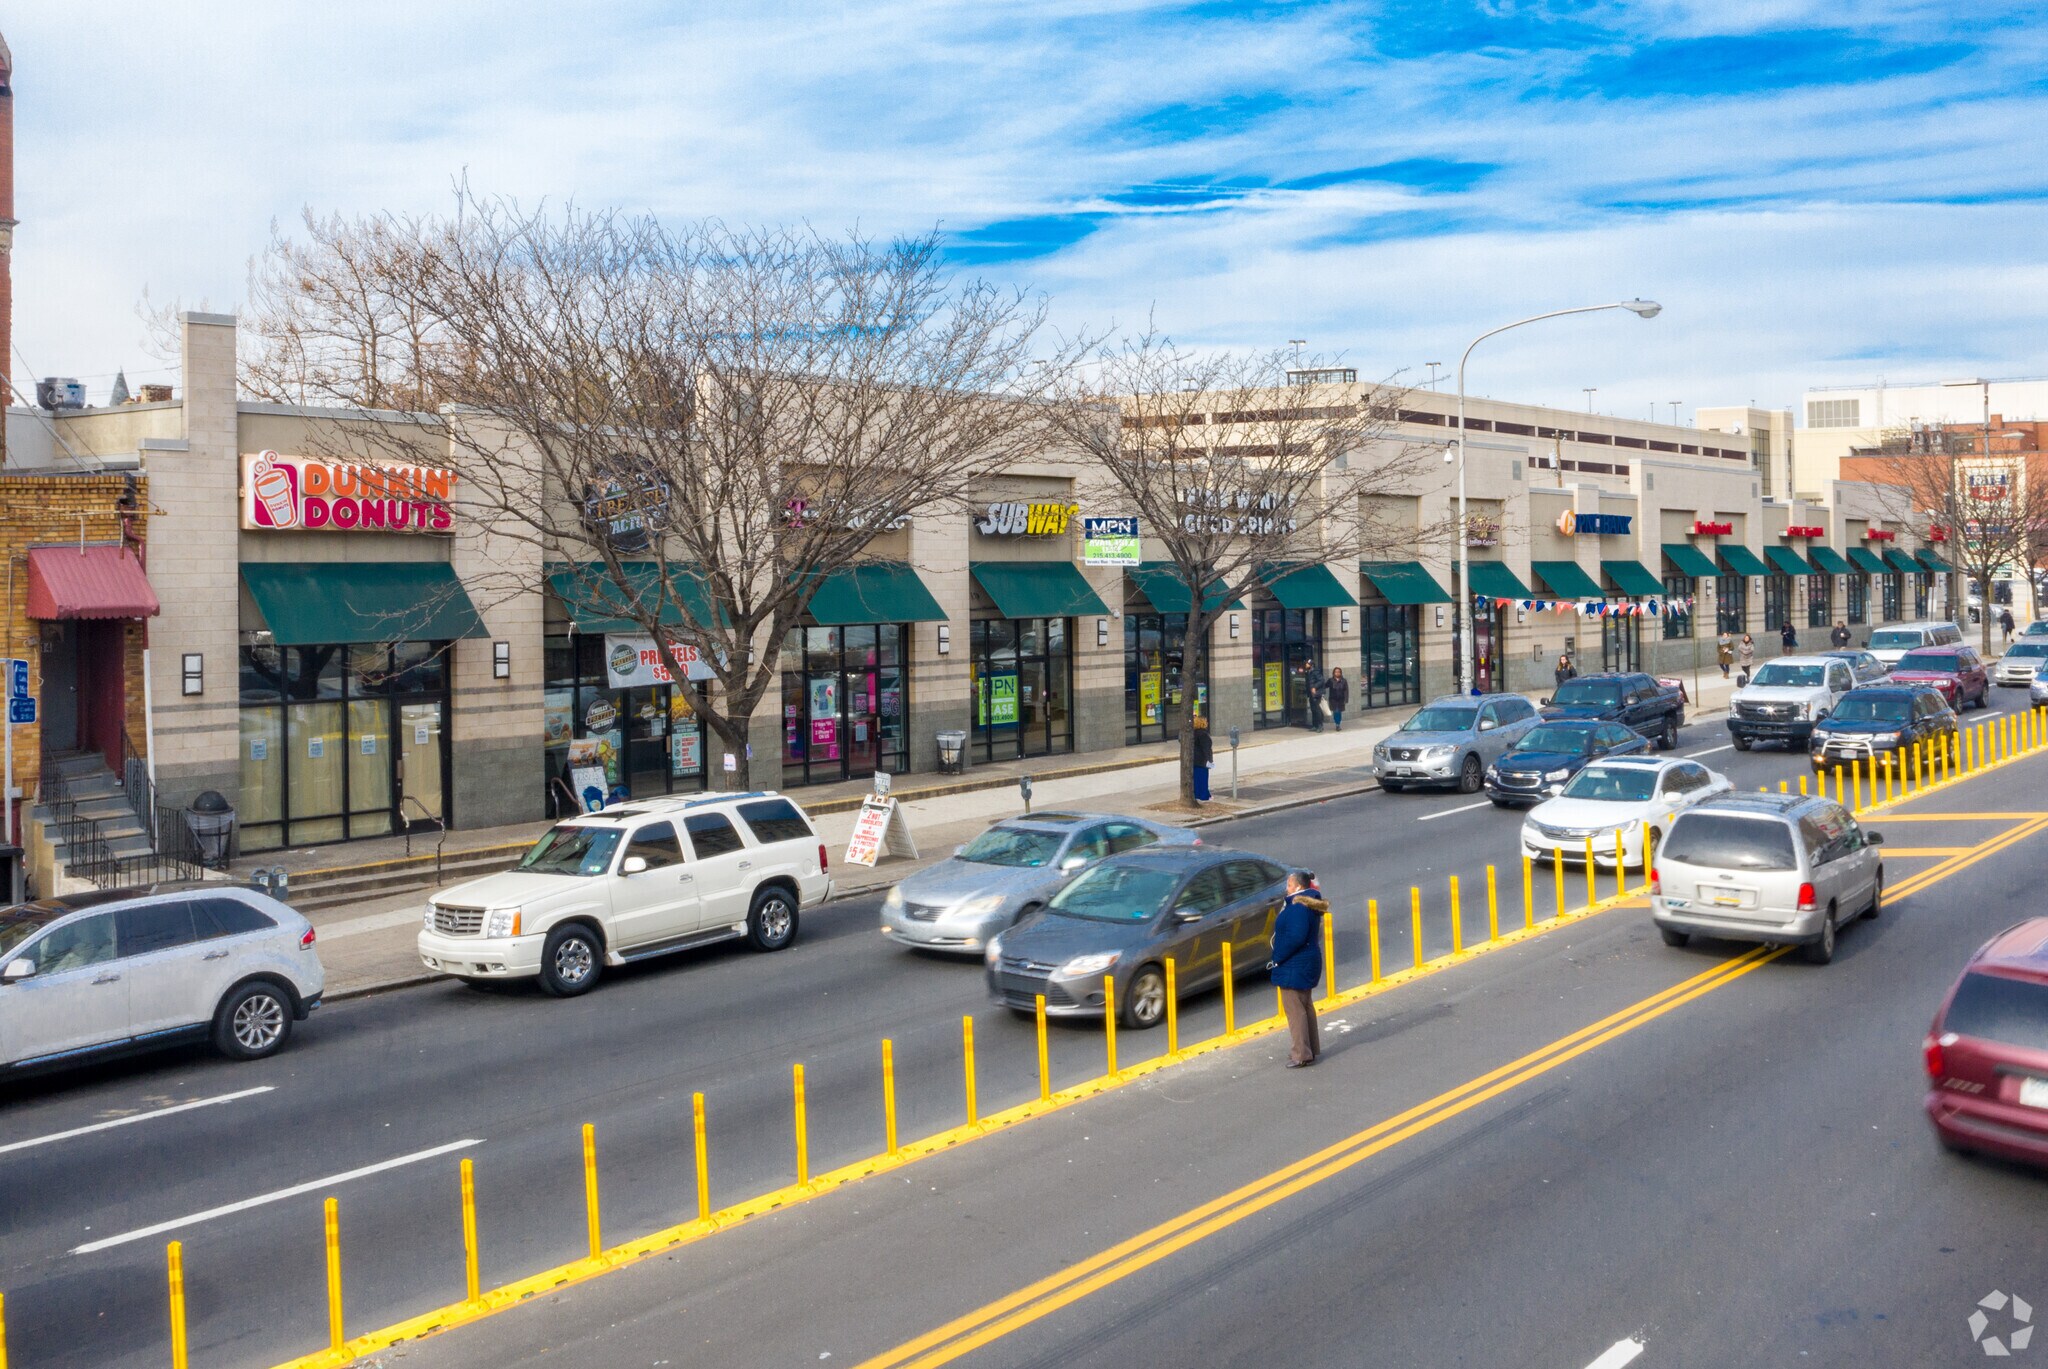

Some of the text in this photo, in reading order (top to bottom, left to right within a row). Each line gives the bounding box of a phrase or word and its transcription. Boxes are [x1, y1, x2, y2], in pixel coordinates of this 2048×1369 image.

[303, 462, 459, 499] DUNKIN'
[303, 497, 452, 530] DONUTS
[979, 503, 1080, 535] SUBWAY
[1091, 520, 1131, 533] MPN
